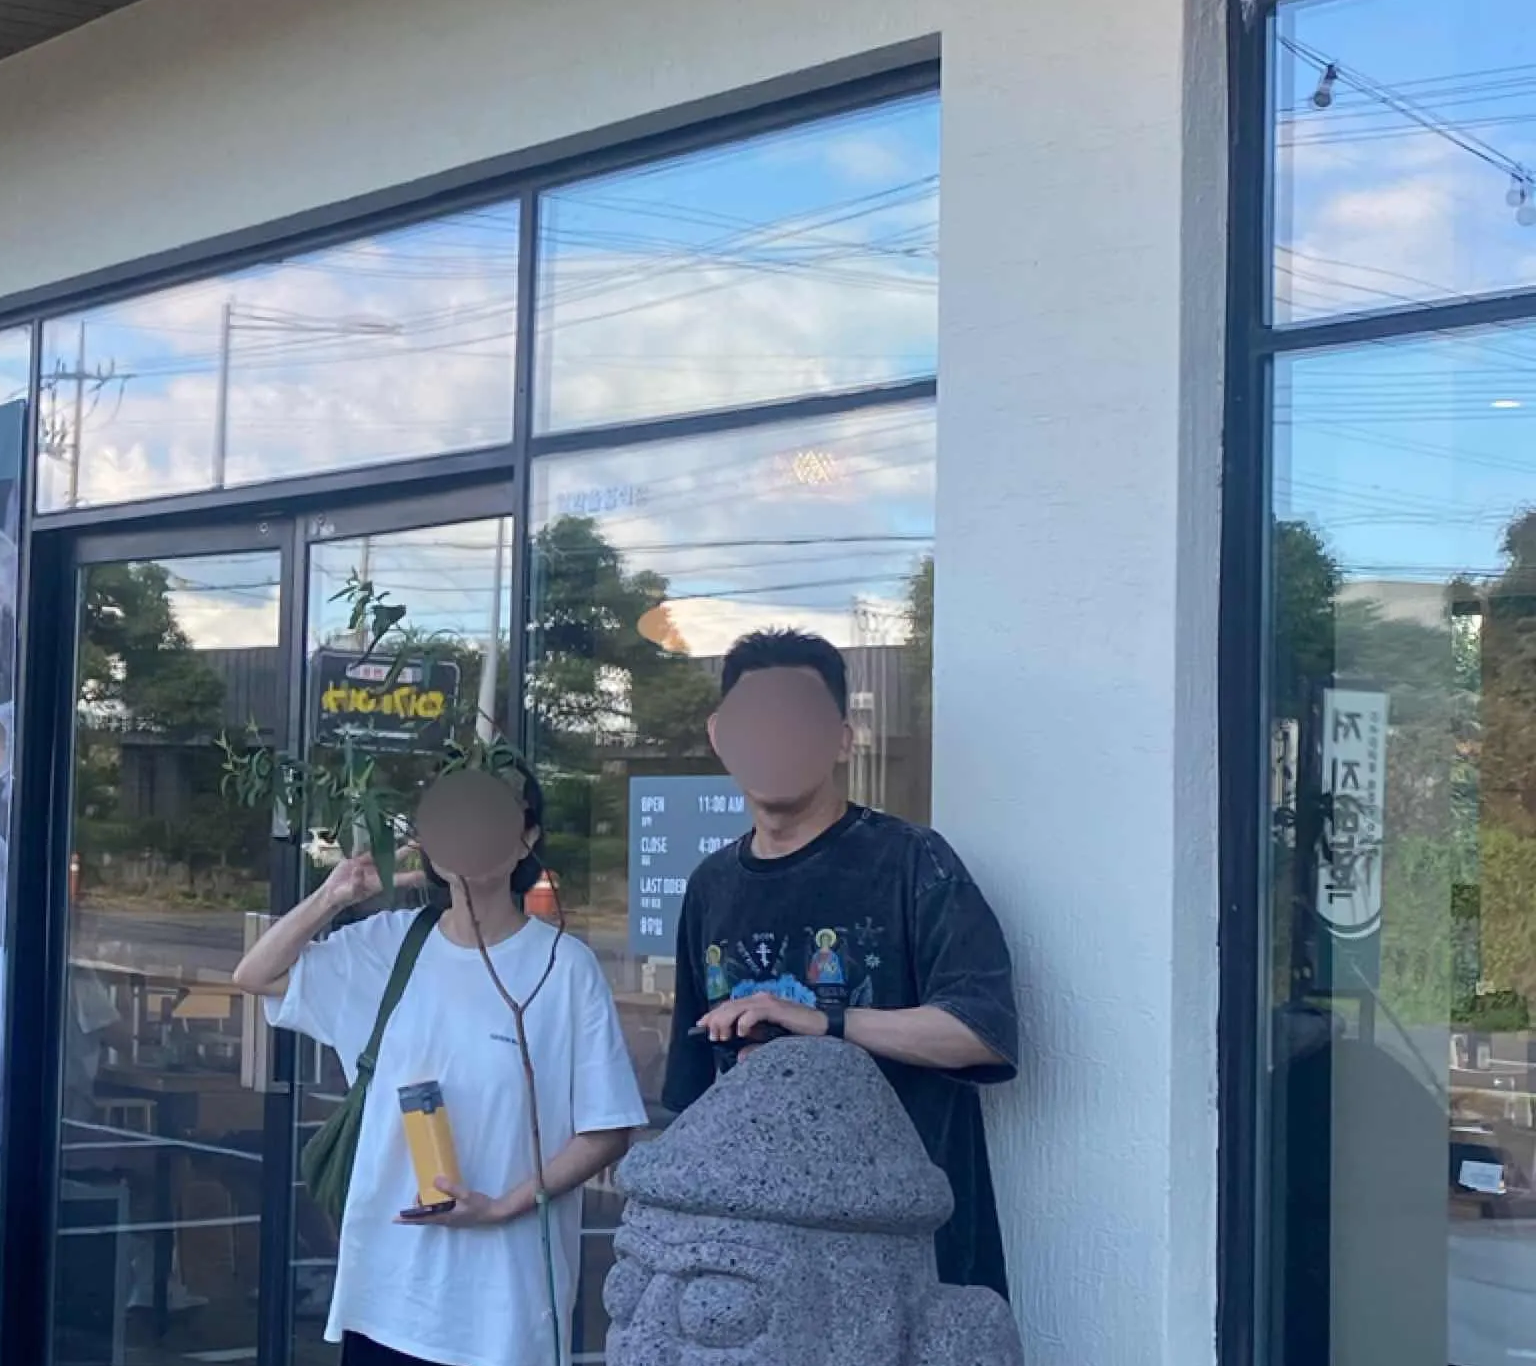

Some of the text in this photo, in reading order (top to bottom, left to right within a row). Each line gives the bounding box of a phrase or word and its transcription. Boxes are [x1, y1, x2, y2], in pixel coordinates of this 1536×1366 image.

[640, 795, 744, 812] OPEN 11:00 AM
[641, 837, 667, 853] CLOSE
[640, 878, 662, 894] LAST
